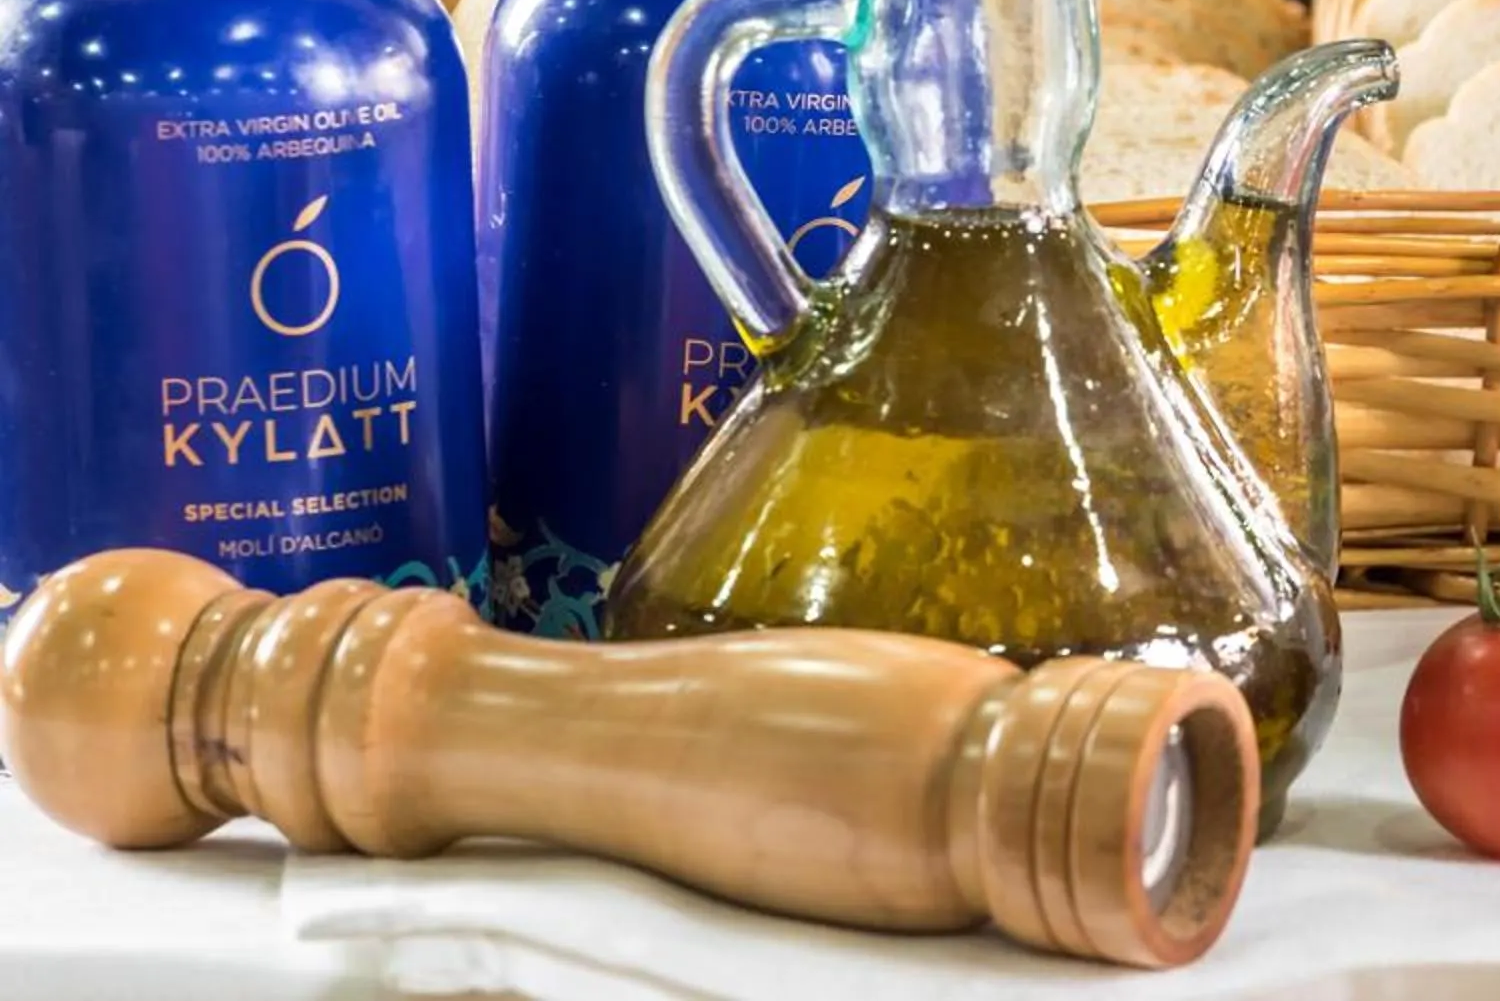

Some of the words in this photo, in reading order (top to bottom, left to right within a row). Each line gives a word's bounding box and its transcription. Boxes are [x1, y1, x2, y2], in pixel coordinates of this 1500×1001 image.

[727, 90, 780, 109] XTRA
[157, 120, 230, 140] EXTRA
[236, 115, 309, 136] VIRGIN
[314, 106, 372, 130] OLIE
[374, 102, 403, 121] OIL
[744, 116, 796, 135] 100%
[803, 118, 858, 137] ARBE
[197, 144, 251, 163] 100%
[683, 338, 749, 379] PR
[162, 356, 417, 416] PRAEDIUM
[163, 400, 417, 467] KYLATT
[184, 501, 285, 521] SPECIAL
[291, 484, 408, 515] SELECTION
[219, 534, 275, 558] MOLÍ
